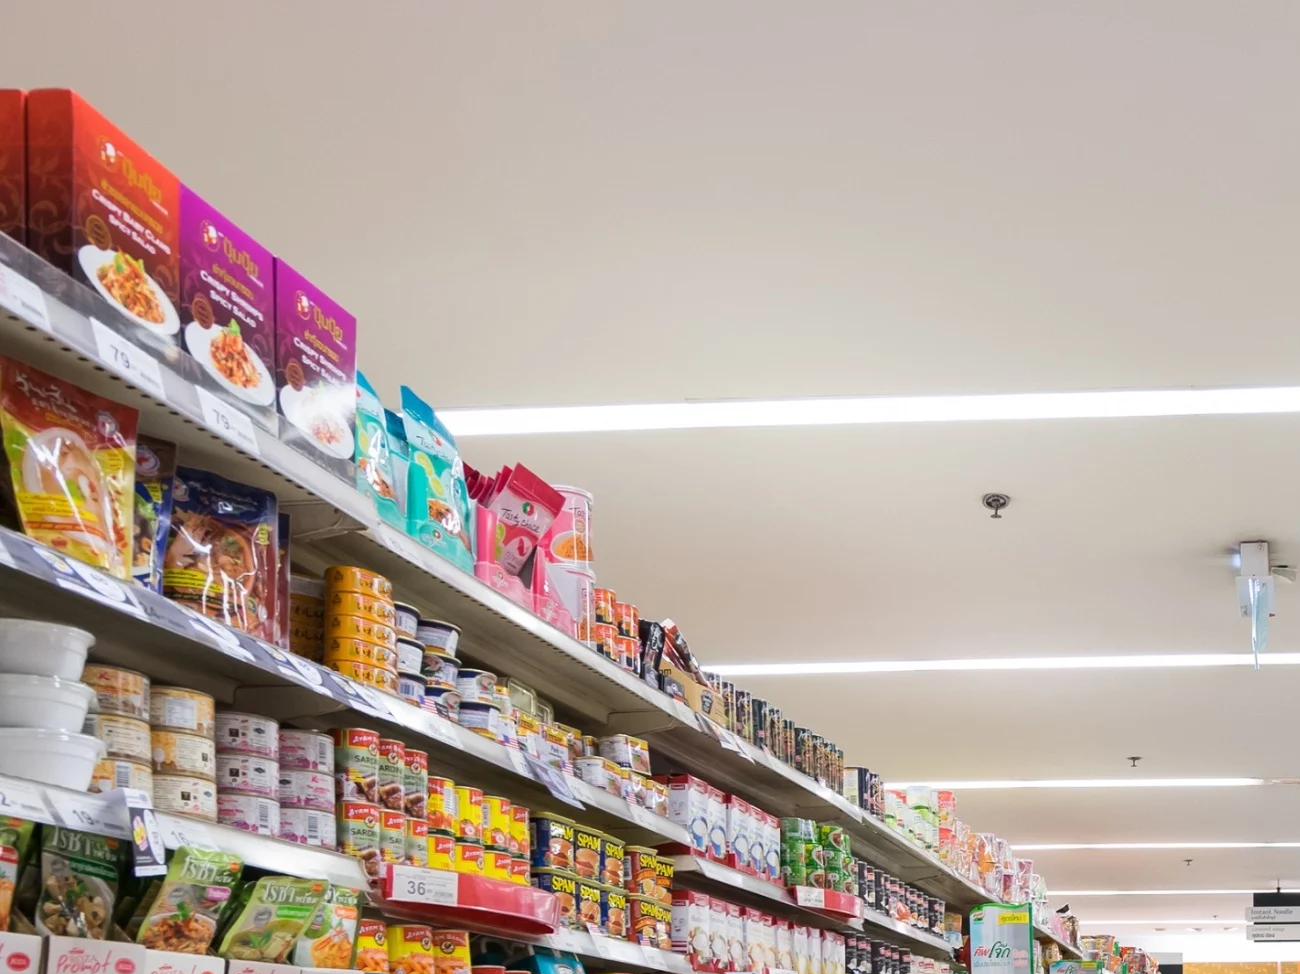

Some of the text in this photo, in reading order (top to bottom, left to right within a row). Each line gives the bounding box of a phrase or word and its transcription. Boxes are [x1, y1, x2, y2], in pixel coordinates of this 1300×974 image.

[200, 269, 230, 296] CRISPY
[232, 304, 257, 328] SALAD
[577, 832, 600, 851] SPAM
[656, 864, 674, 878] PAM
[408, 881, 426, 896] 36
[552, 876, 575, 894] SPAM
